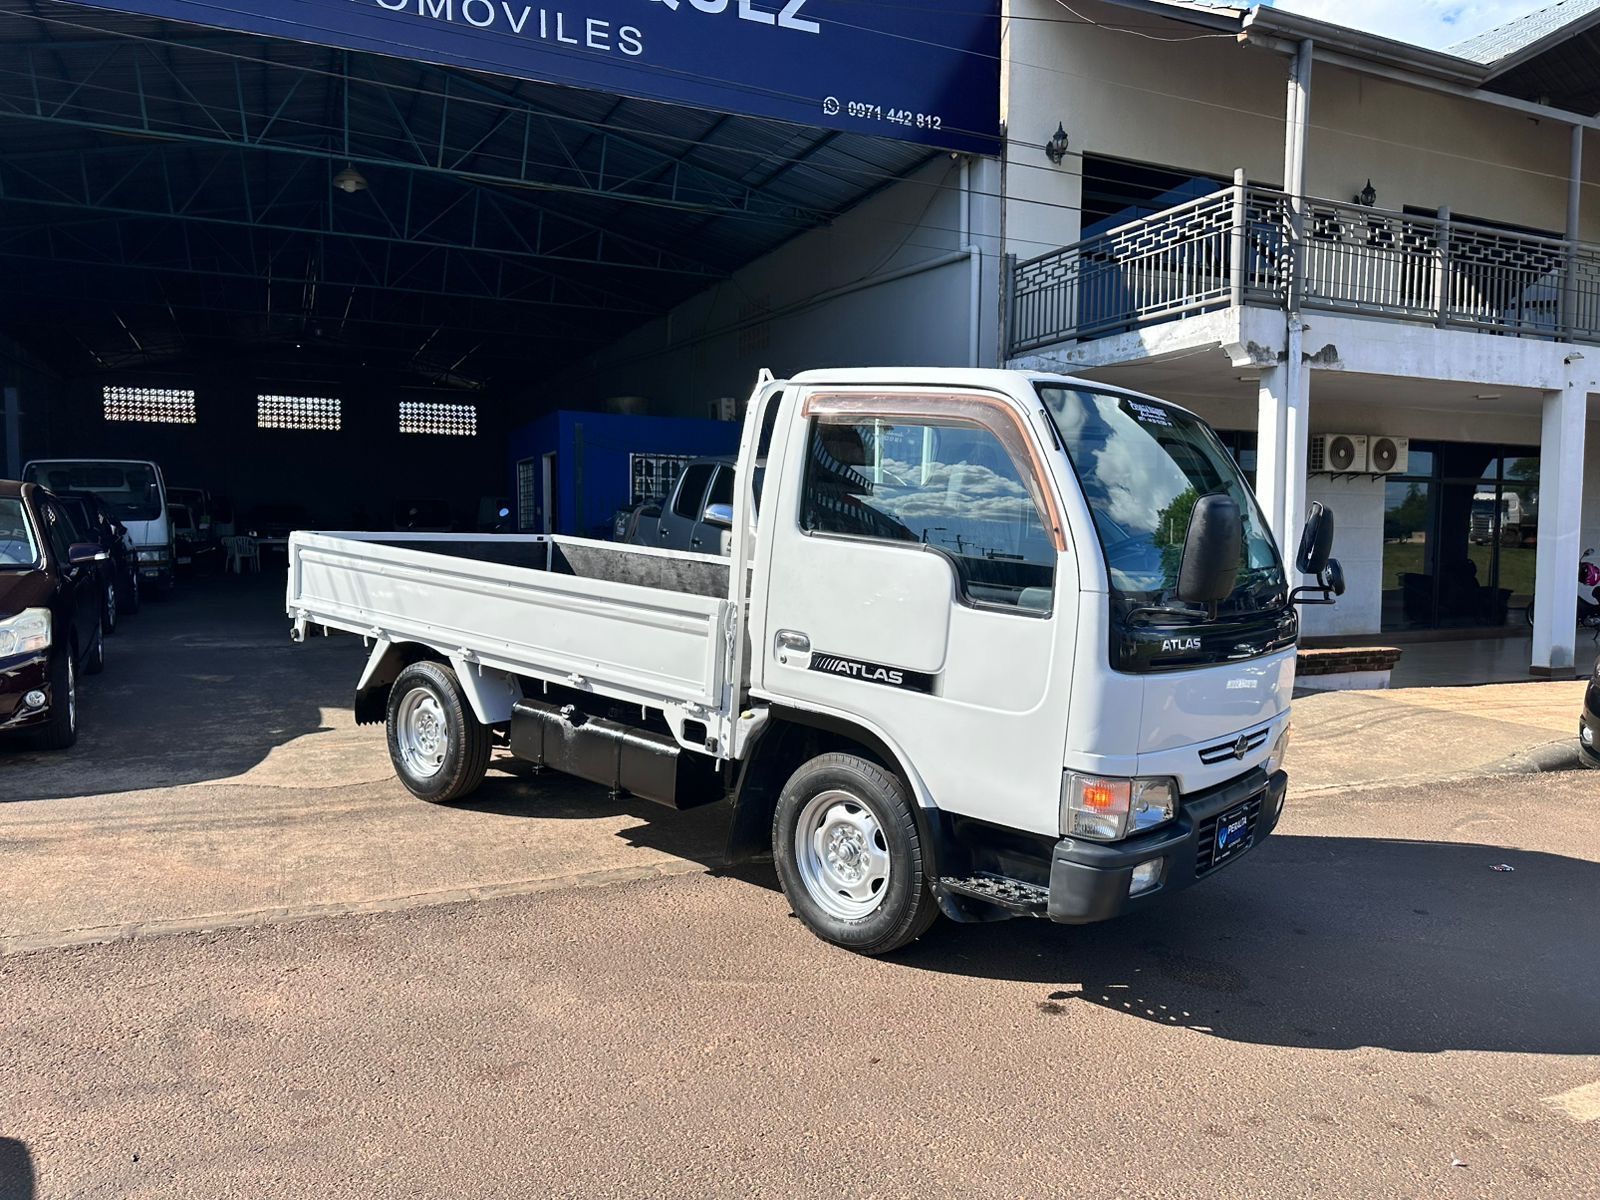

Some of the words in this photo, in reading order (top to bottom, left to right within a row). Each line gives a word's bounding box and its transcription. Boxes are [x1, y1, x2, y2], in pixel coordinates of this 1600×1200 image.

[848, 101, 881, 121] 0971
[886, 108, 912, 126] 442
[916, 113, 942, 130] 812
[1161, 637, 1201, 652] ATLAS
[836, 661, 904, 684] ATLAS
